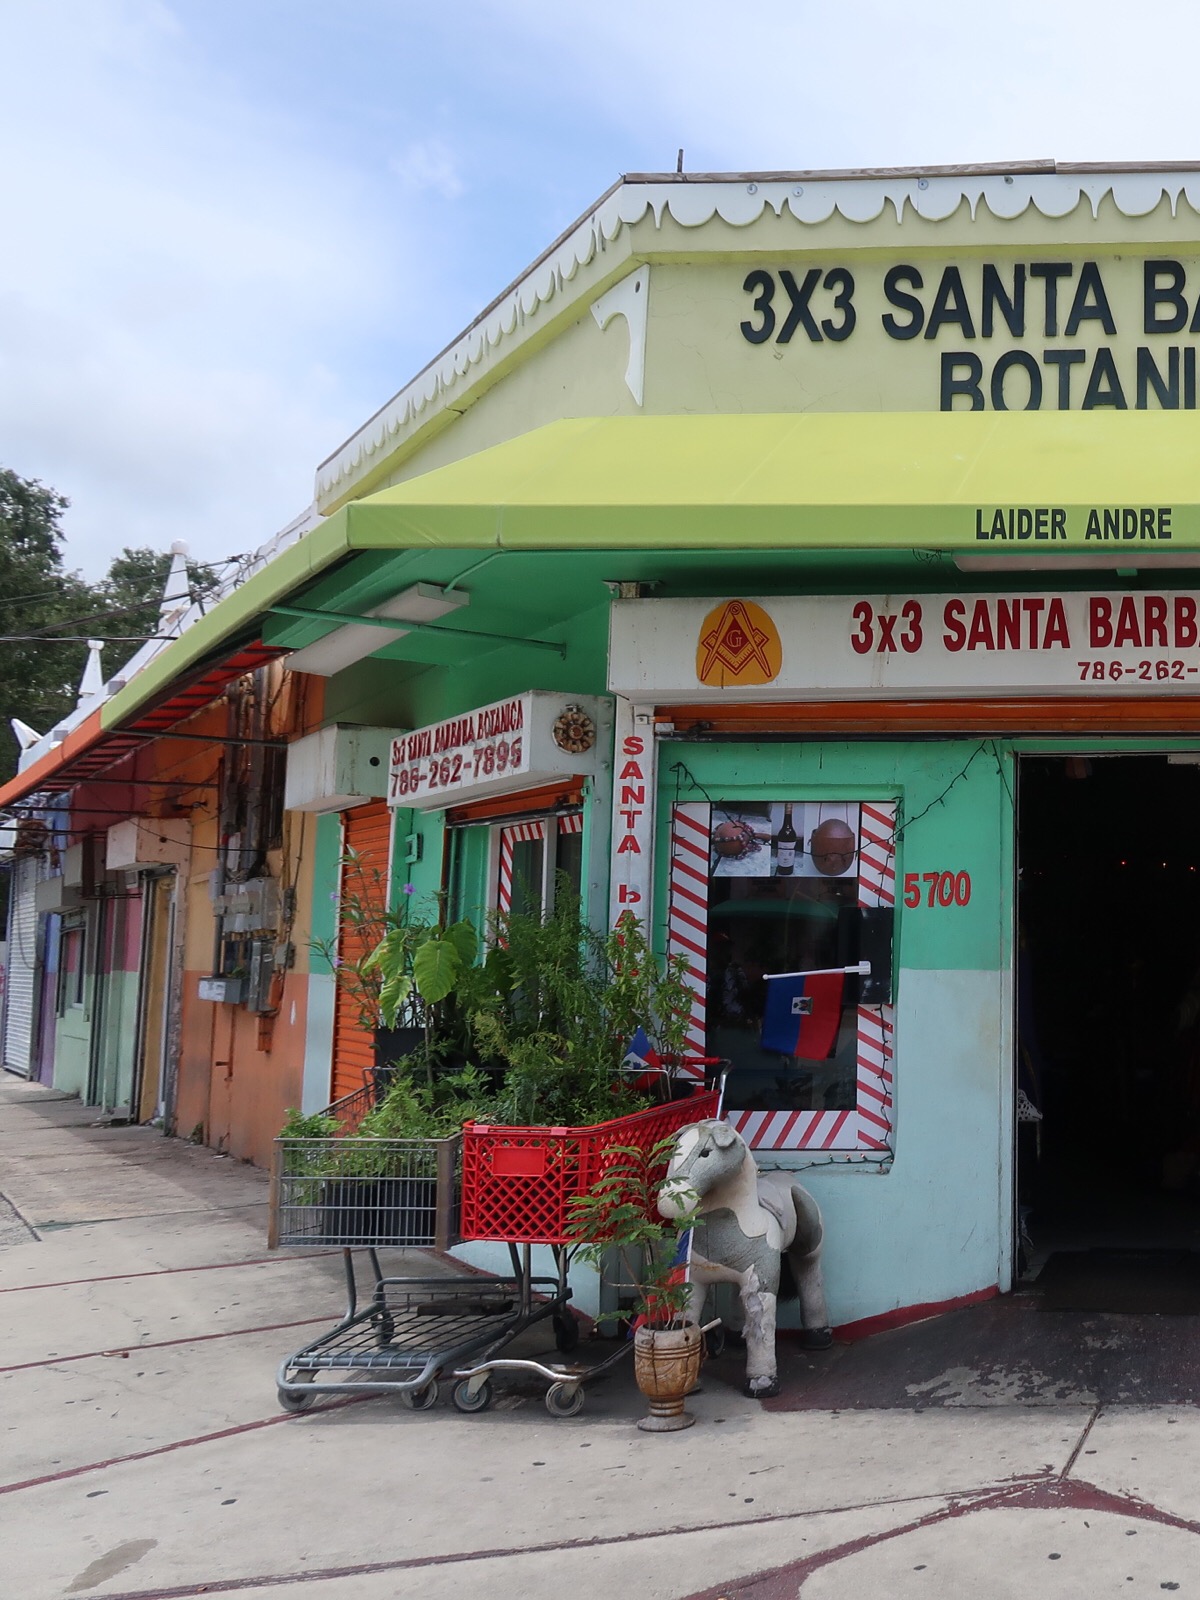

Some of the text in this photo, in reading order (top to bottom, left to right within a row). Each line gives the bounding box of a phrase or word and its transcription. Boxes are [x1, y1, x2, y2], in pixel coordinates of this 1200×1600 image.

[740, 267, 857, 345] 3X3
[881, 261, 1118, 340] SANTA
[975, 507, 1173, 541] LAIDER ANDRE
[850, 600, 923, 654] 3x3
[942, 596, 1071, 652] SANTA
[407, 730, 432, 760] SANTA
[433, 716, 476, 754] BARBARA
[477, 700, 524, 740] BOTANICA
[390, 736, 523, 798] 786-262-7895
[617, 736, 645, 854] SANTA
[903, 870, 972, 909] 5700
